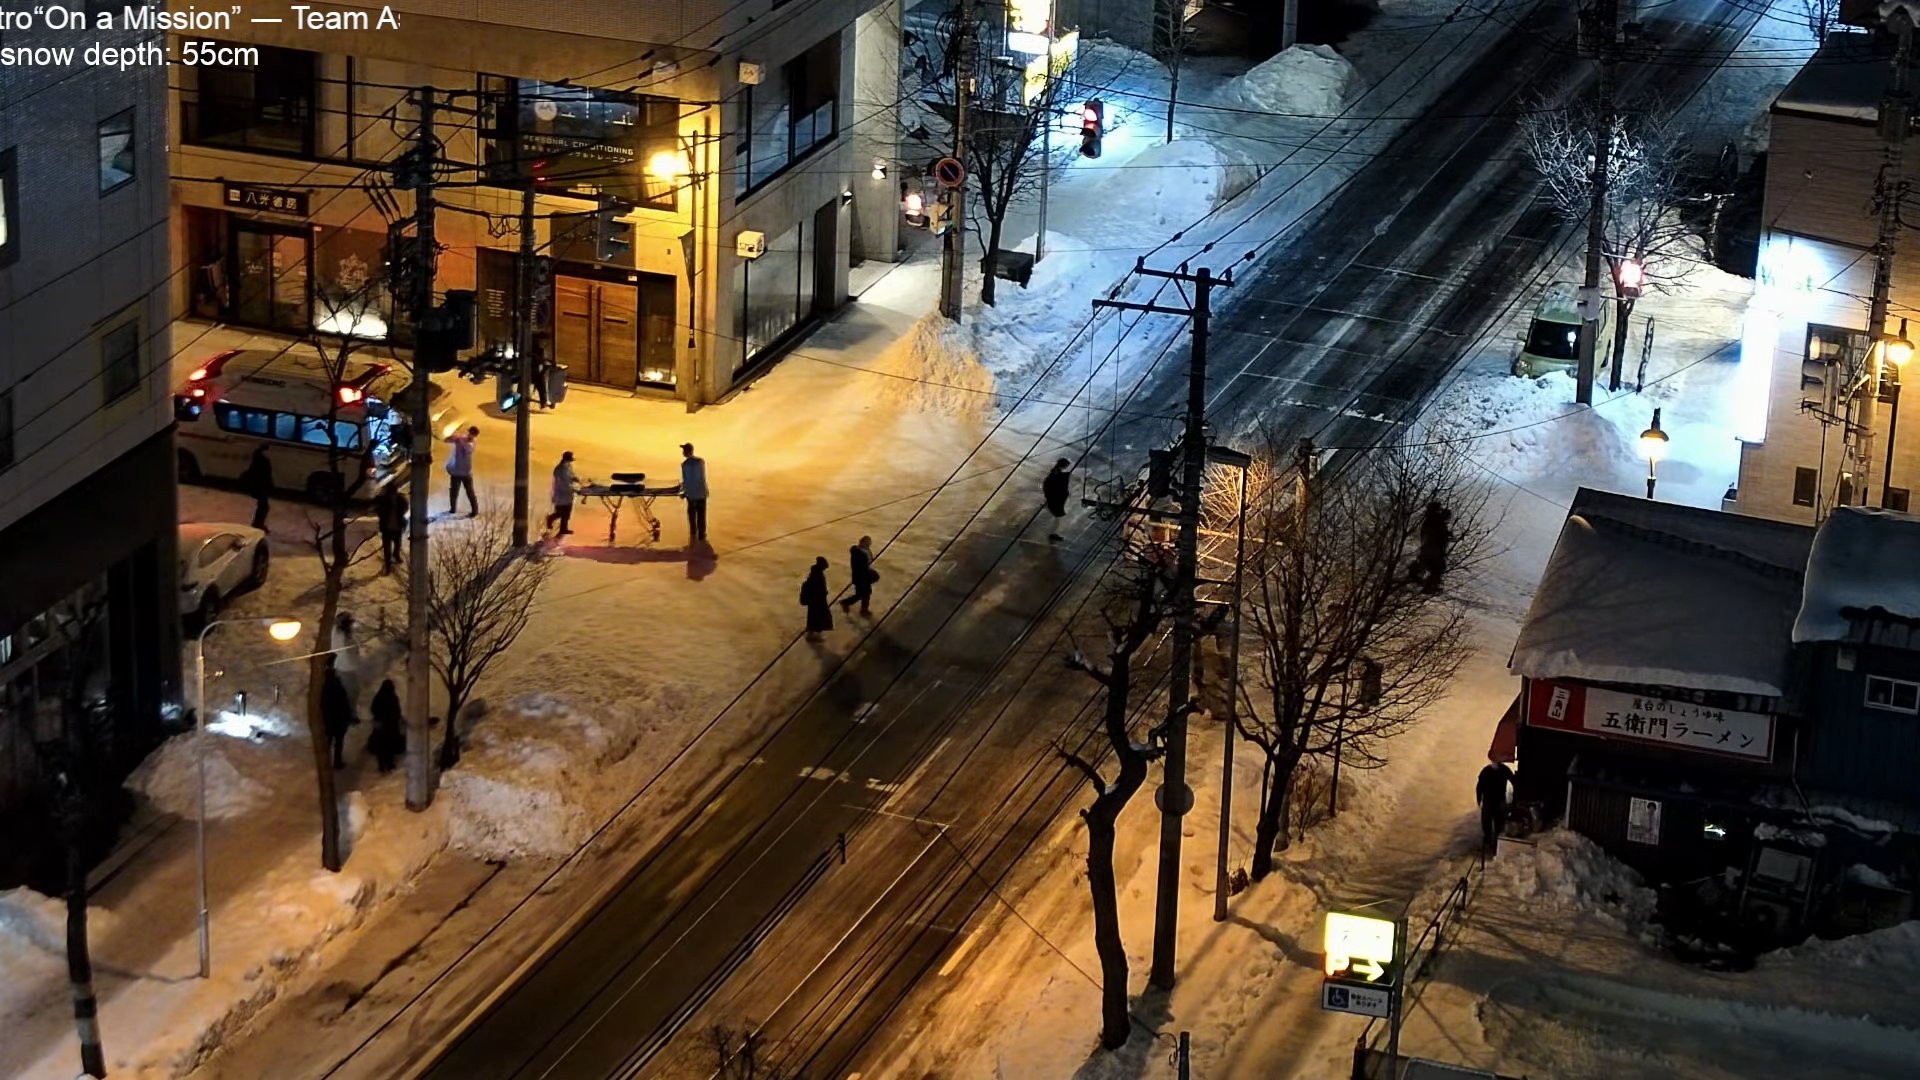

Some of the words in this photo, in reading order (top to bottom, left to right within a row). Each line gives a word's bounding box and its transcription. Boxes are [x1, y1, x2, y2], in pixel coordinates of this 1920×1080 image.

[1602, 711, 1755, 749] 五衛門ラーメン
